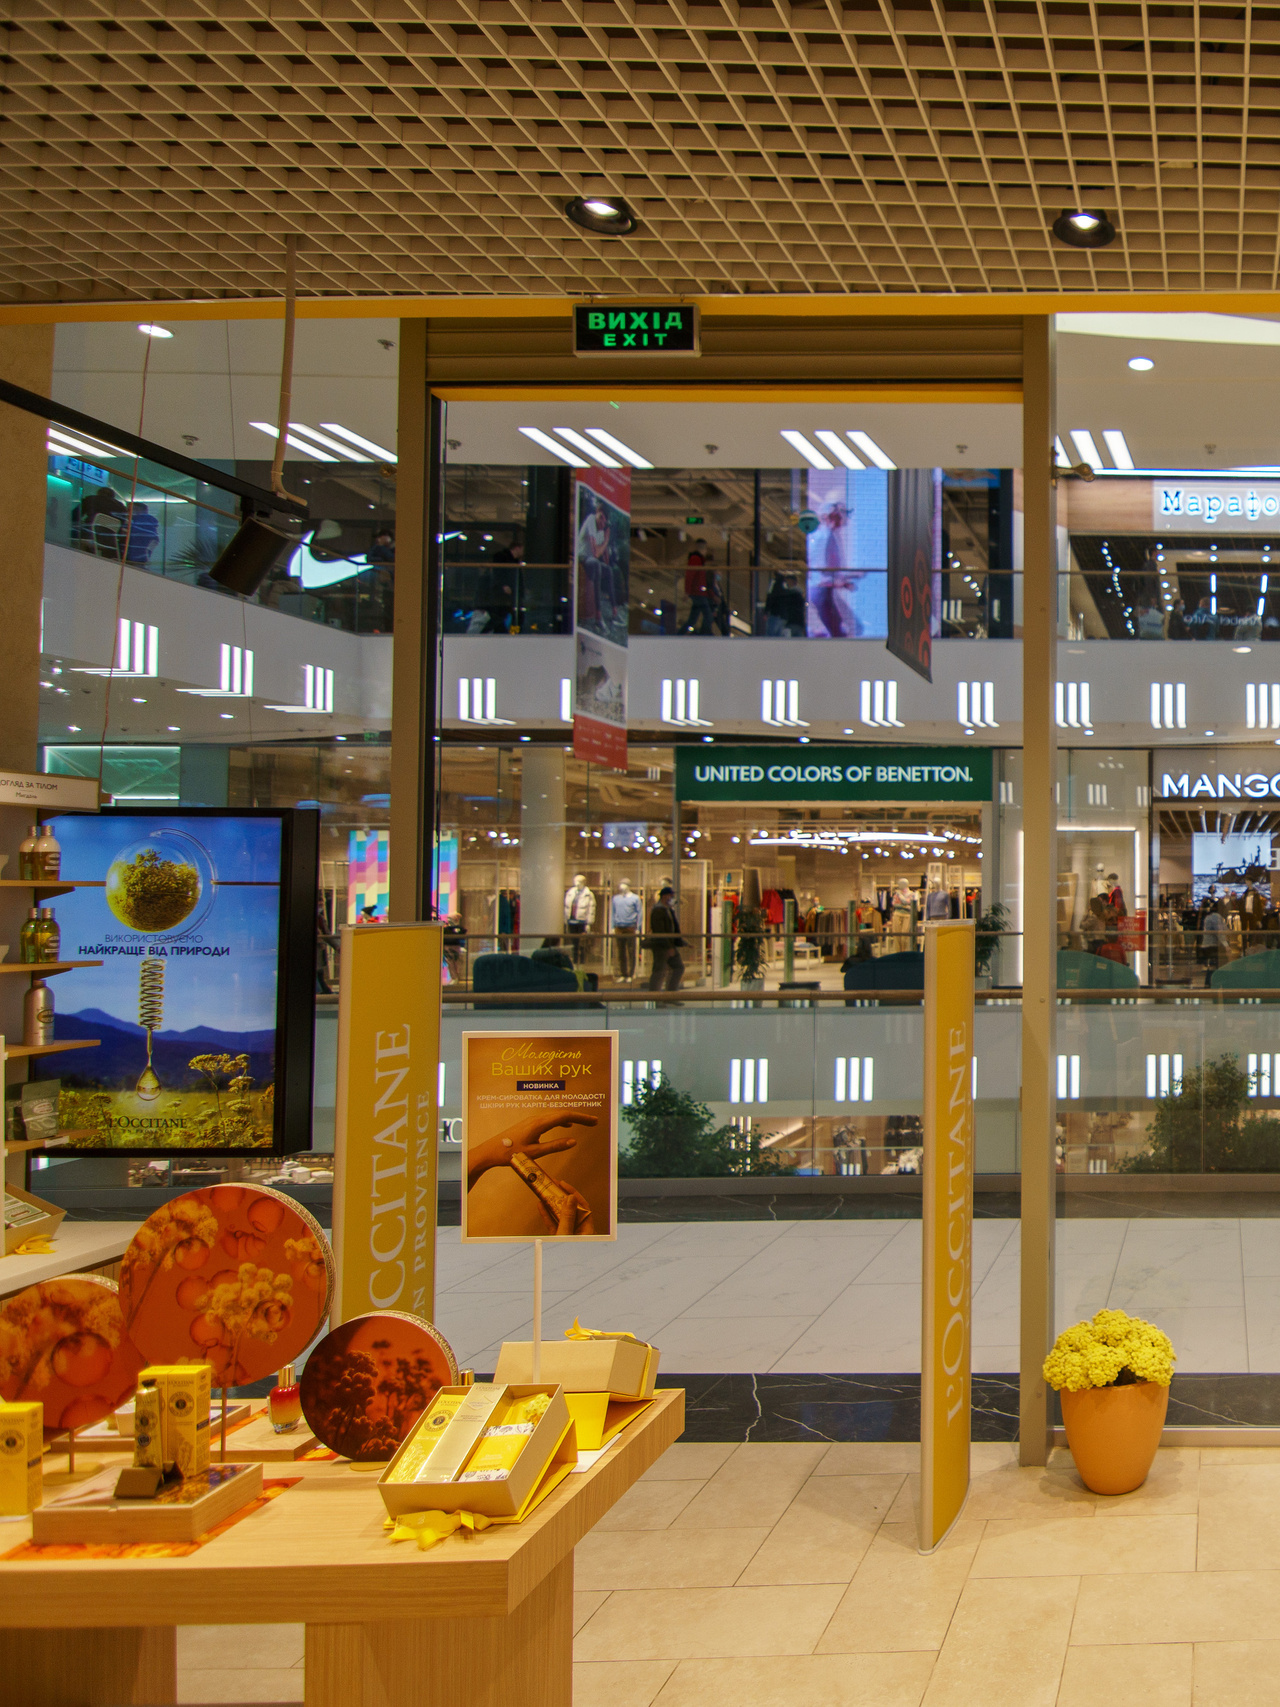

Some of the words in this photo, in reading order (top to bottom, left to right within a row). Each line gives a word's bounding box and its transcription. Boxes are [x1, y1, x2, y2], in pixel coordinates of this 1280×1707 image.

[588, 312, 682, 330] ВИХІД
[603, 333, 668, 346] EXIT
[695, 766, 764, 782] UNITED
[767, 766, 842, 782] COLORS
[845, 766, 872, 782] OF
[876, 766, 973, 782] BENETTON.
[0, 780, 24, 788] ОГЛЯД
[36, 782, 58, 790] ТІЛОМ
[78, 944, 146, 956] НАЙКРАЩЕ
[148, 946, 168, 956] ВІД
[171, 946, 230, 957] ПРИРОДИ
[501, 1042, 582, 1072] Молодість
[491, 1062, 554, 1076] Ваших
[559, 1063, 592, 1078] рук
[544, 1093, 560, 1101] ДЛЯ
[413, 1090, 430, 1274] PROVENCE
